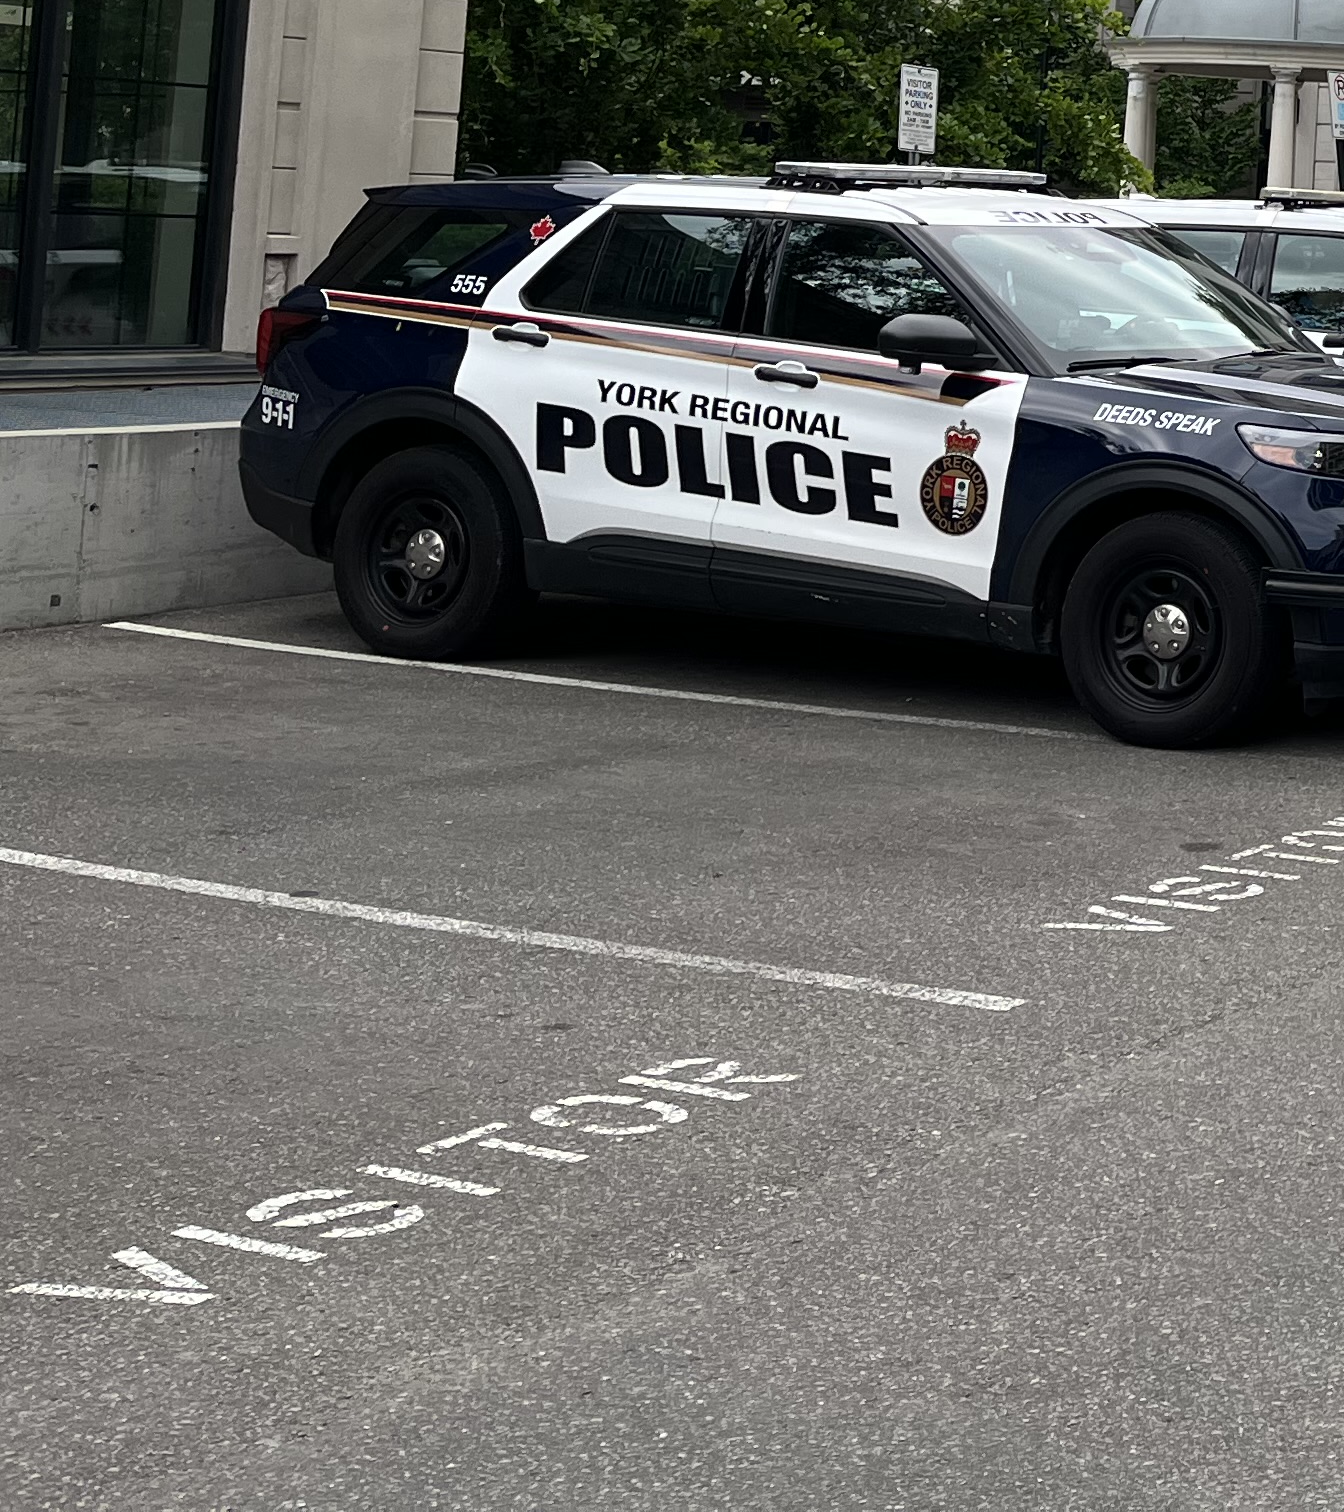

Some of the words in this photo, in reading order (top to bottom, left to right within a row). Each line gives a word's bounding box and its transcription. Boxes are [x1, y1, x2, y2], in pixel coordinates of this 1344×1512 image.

[907, 79, 932, 90] VISITOR
[450, 274, 488, 295] 555
[261, 397, 294, 429] 9-1-1
[597, 378, 681, 415] YORK
[689, 393, 849, 441] REGIONAL
[1093, 403, 1157, 426] DEEDS
[1154, 411, 1221, 436] SPEAK
[536, 402, 899, 528] POLICE
[922, 465, 942, 511] YORK
[942, 456, 986, 514] REGIONAL
[932, 510, 973, 532] POLICE
[8, 1056, 800, 1306] VISITOR
